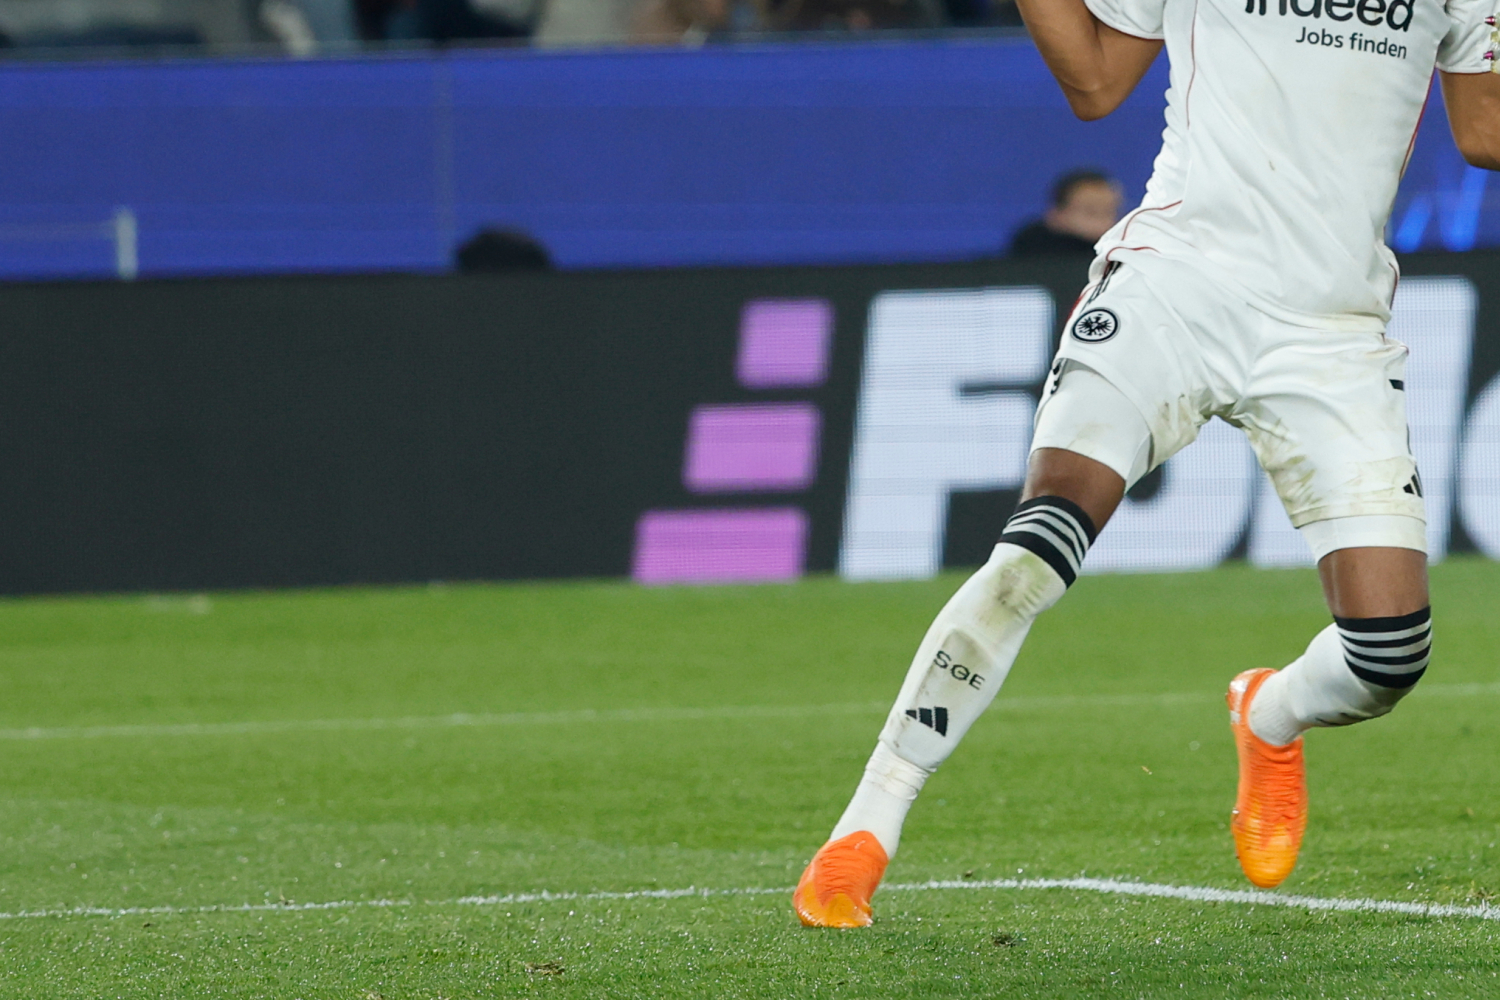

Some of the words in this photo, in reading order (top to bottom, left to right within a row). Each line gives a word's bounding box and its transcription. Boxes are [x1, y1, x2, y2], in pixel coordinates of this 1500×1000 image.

[1295, 26, 1344, 48] Jobs
[1348, 31, 1408, 59] finden
[933, 649, 986, 691] SGE
